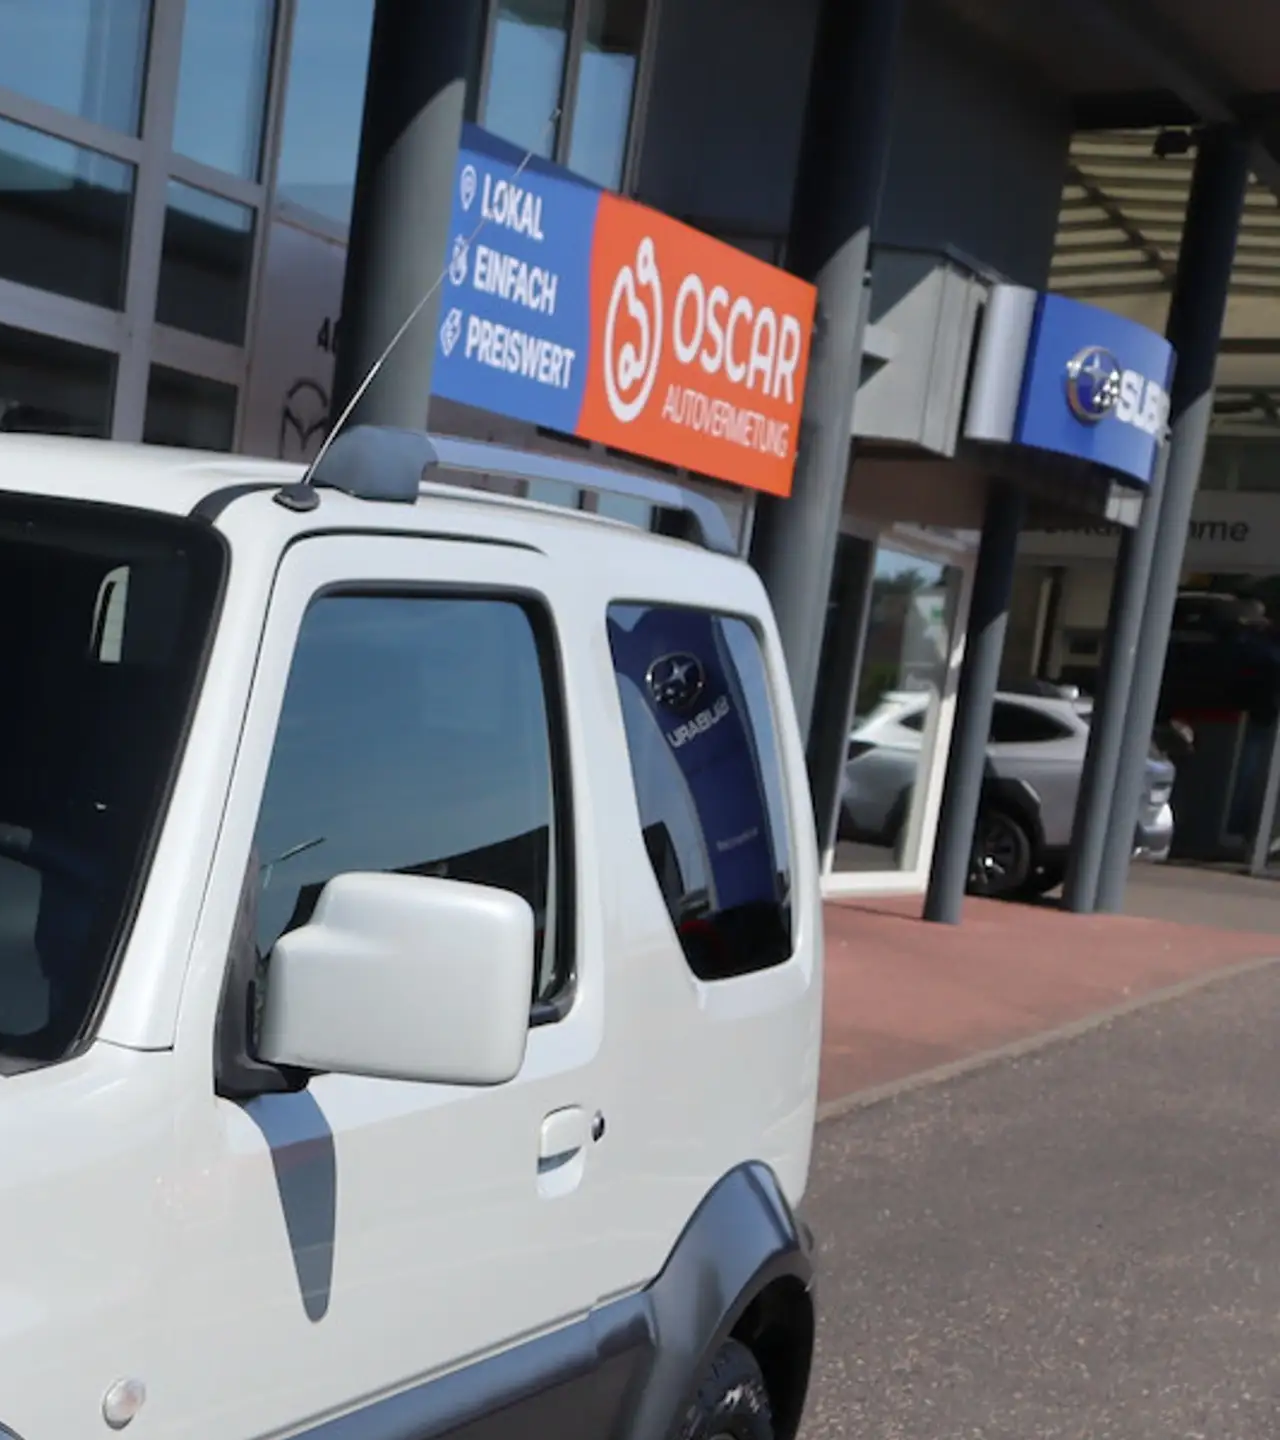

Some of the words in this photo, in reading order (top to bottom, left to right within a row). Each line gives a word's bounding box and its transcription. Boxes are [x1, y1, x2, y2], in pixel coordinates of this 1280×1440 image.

[481, 173, 544, 240] LOKAL
[473, 245, 558, 315] EINFACH
[465, 314, 576, 389] PREISWERT
[672, 273, 802, 403] OSCAR
[662, 384, 789, 458] AUTOVERMIETUNG
